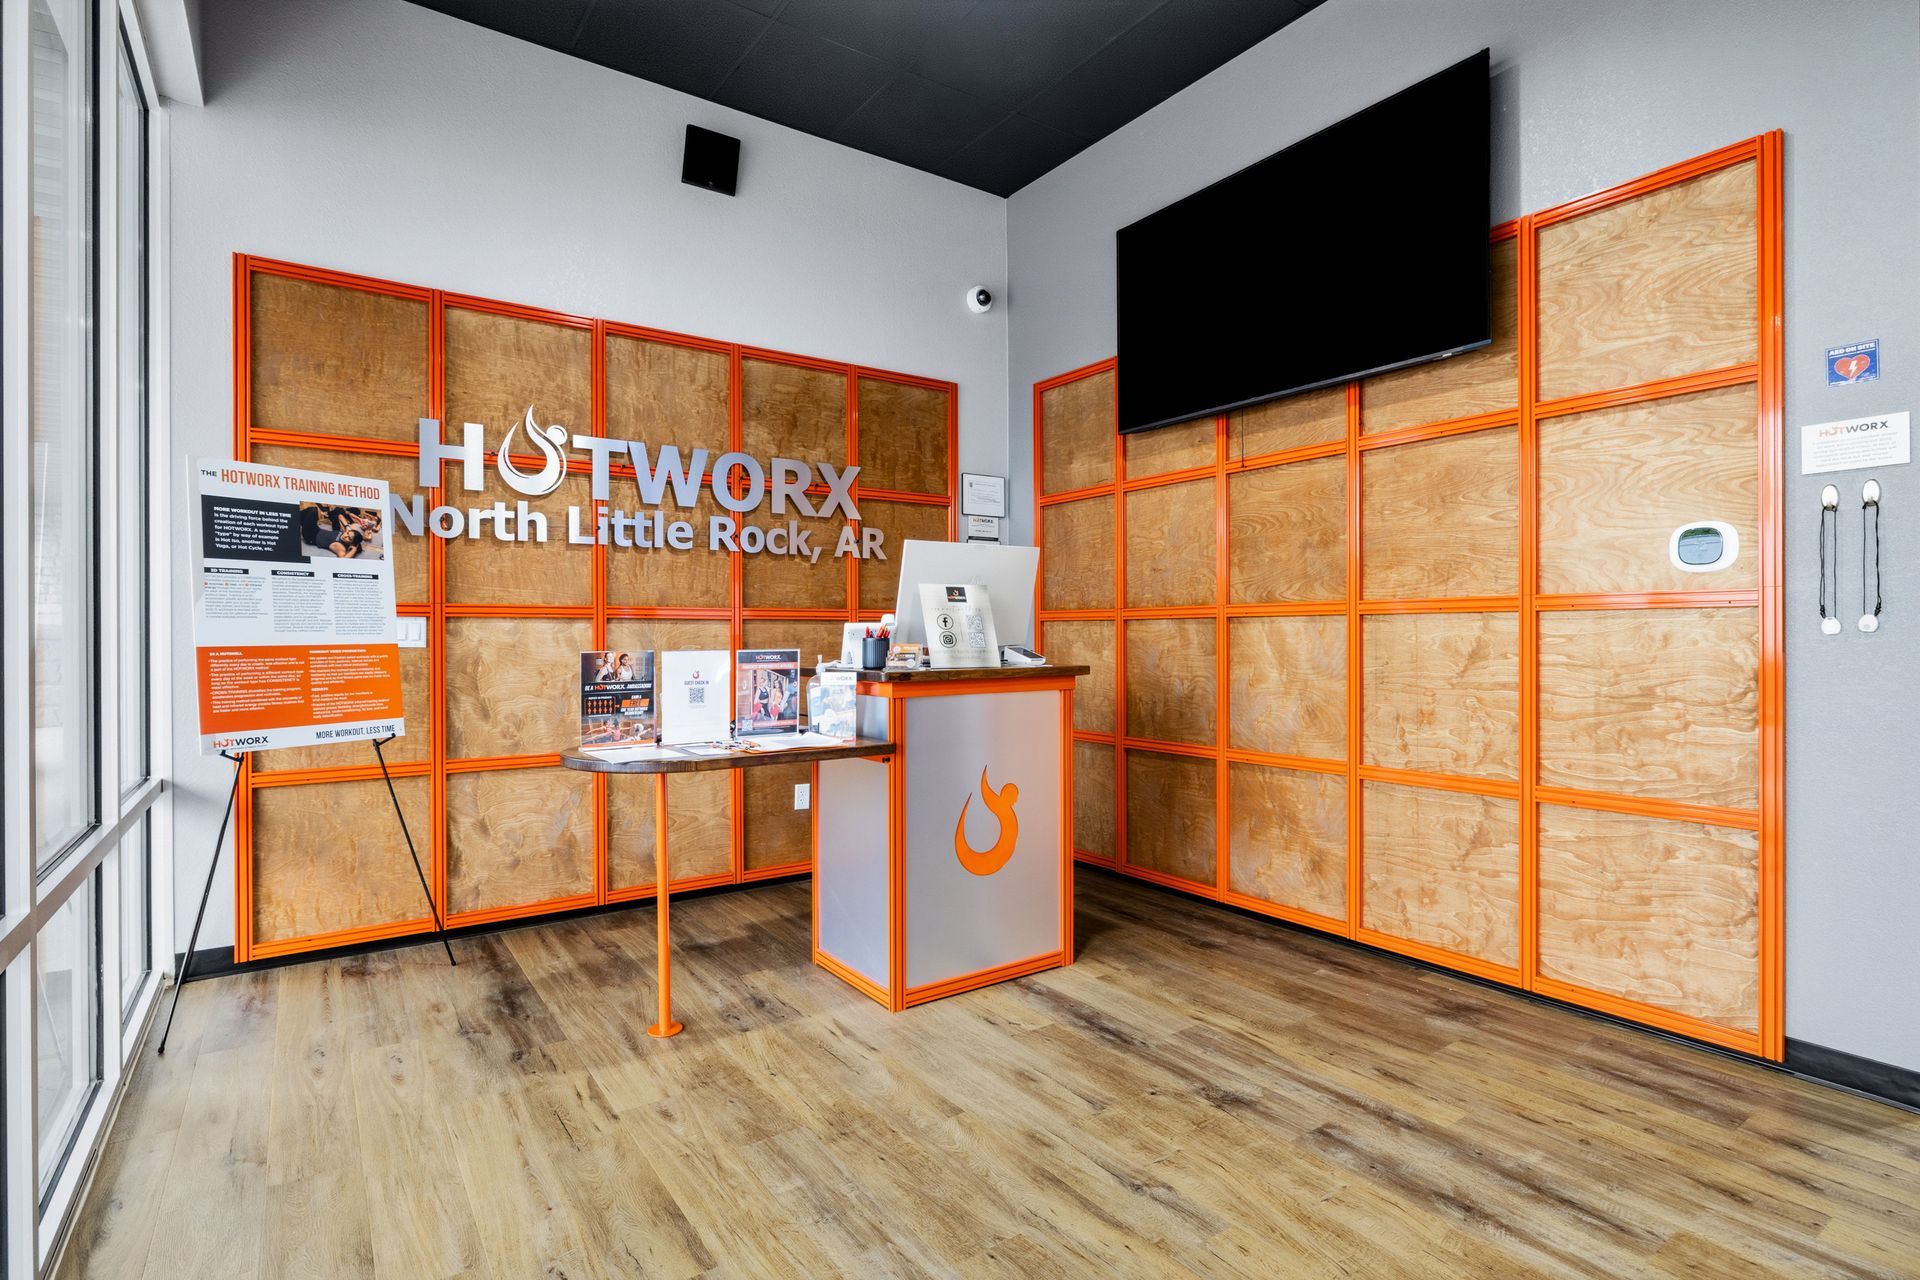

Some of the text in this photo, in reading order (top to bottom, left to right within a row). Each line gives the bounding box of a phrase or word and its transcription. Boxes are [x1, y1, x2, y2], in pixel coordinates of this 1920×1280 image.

[1858, 342, 1876, 350] SITE
[1819, 420, 1888, 438] HOTWORX
[418, 403, 862, 520] HOTWORX
[200, 468, 380, 500] THE HOTWORX TRAINING METHOD
[390, 493, 888, 565] North Little Rock, AR
[316, 724, 395, 739] MORE WORKOUT, LESS TIME
[214, 736, 269, 748] HOTWORX
